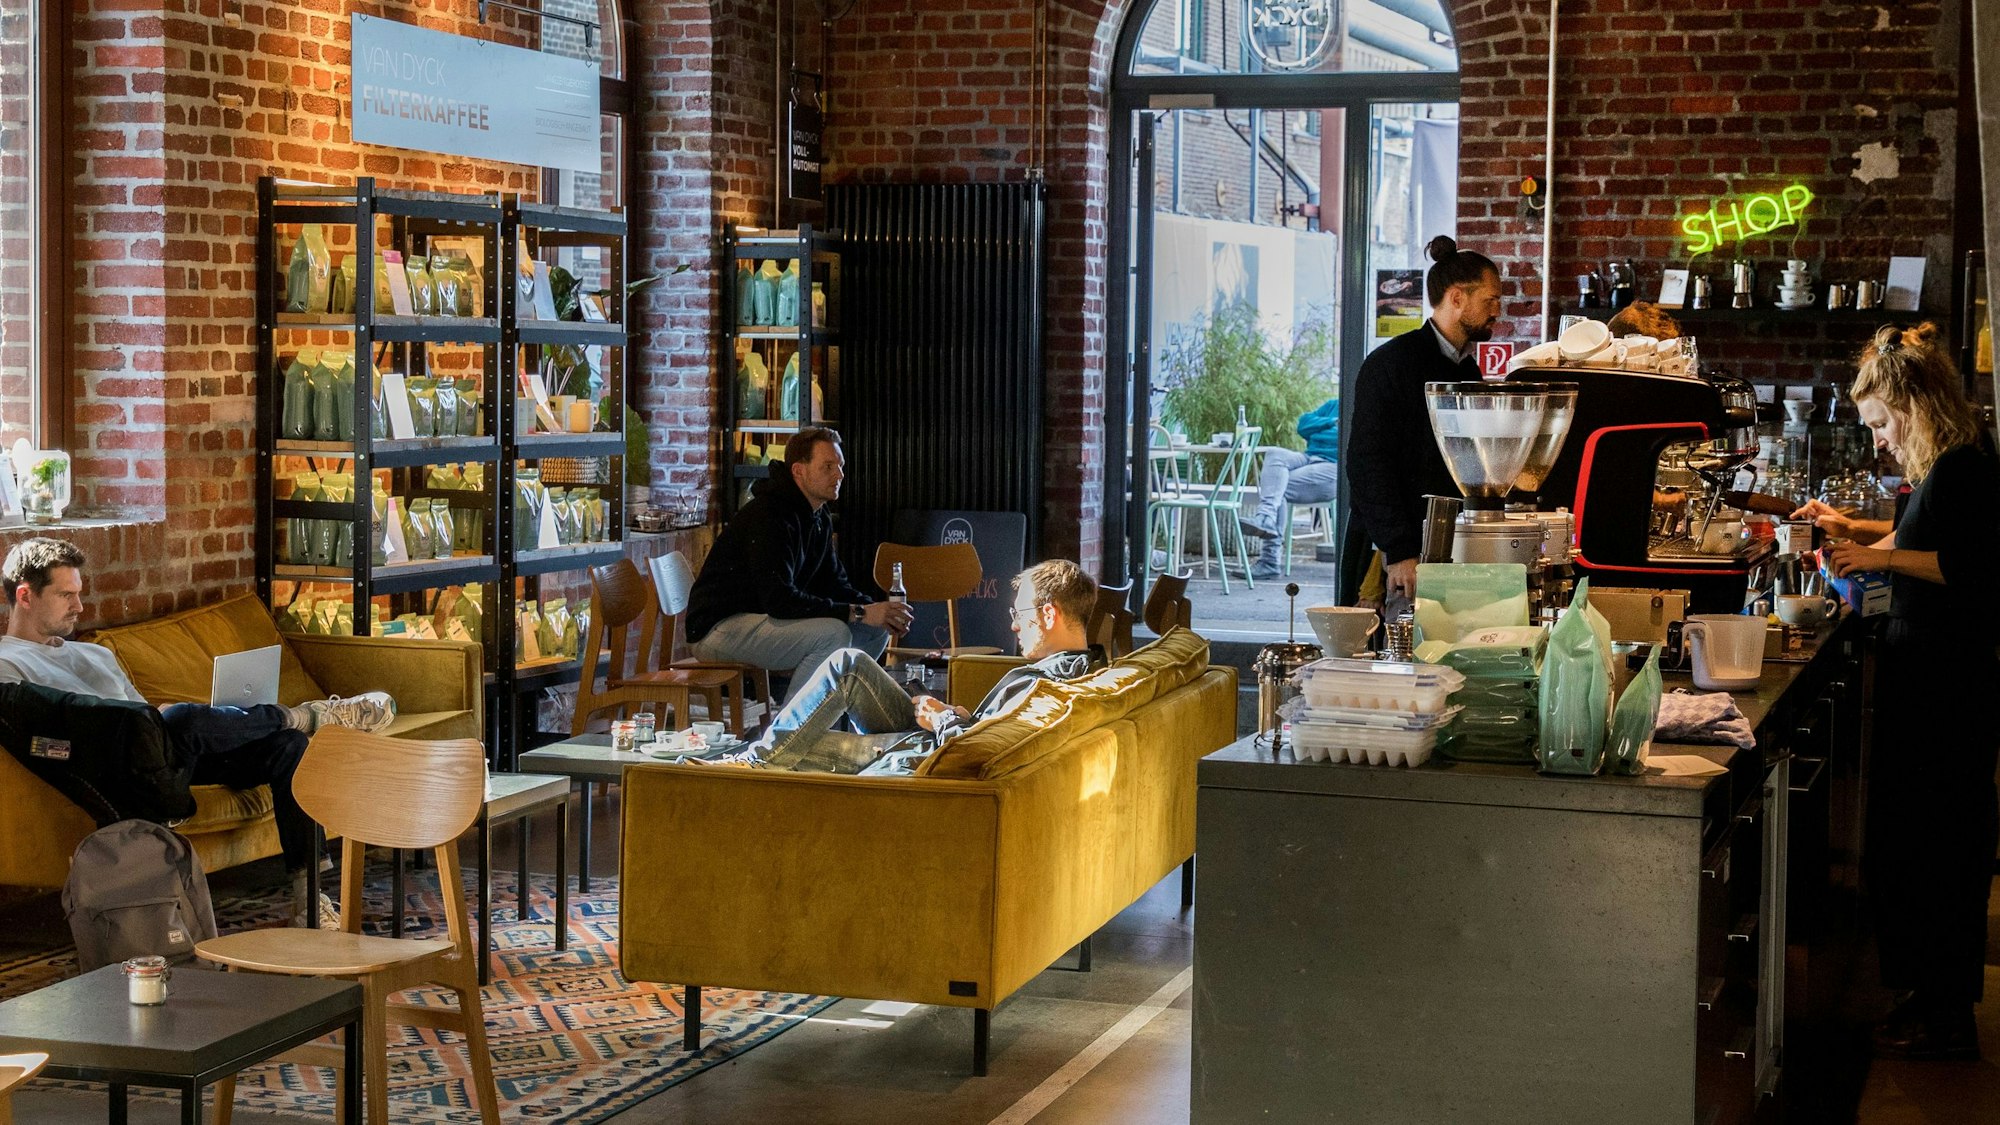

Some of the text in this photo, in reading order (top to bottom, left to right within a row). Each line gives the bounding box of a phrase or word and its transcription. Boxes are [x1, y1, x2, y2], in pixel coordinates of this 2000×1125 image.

[362, 44, 447, 87] VAN DYCK
[363, 83, 490, 130] FILTERKAFFEE
[793, 144, 810, 157] VOLL-
[793, 159, 820, 173] AUTOMAT
[1682, 184, 1811, 252] SHOP
[947, 529, 966, 538] VAN
